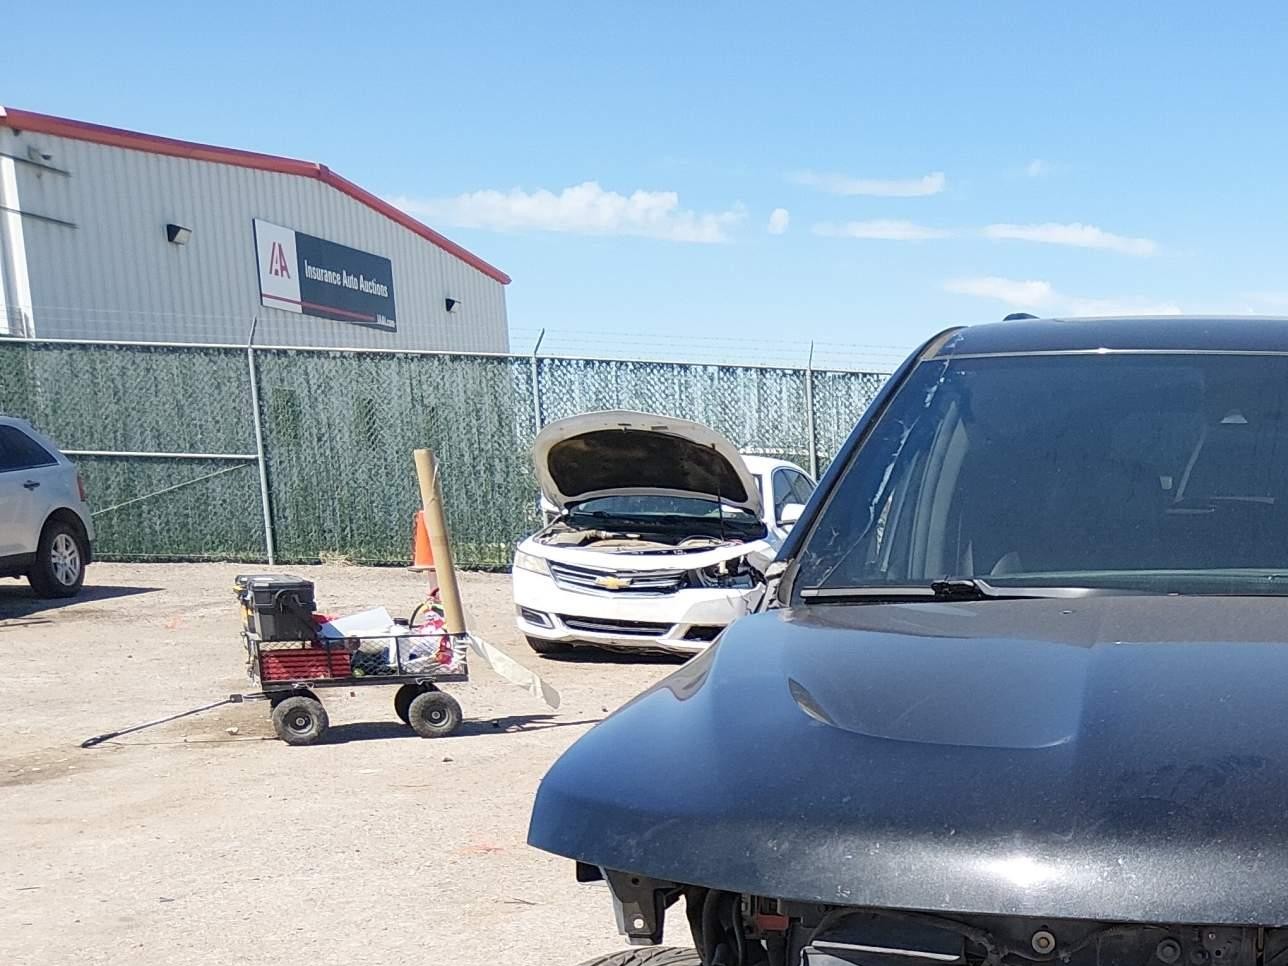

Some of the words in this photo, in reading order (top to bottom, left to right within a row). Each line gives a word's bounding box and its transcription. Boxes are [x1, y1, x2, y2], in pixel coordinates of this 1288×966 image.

[304, 259, 341, 285] Insurance
[342, 270, 359, 290] Auto
[359, 275, 388, 298] Auctions
